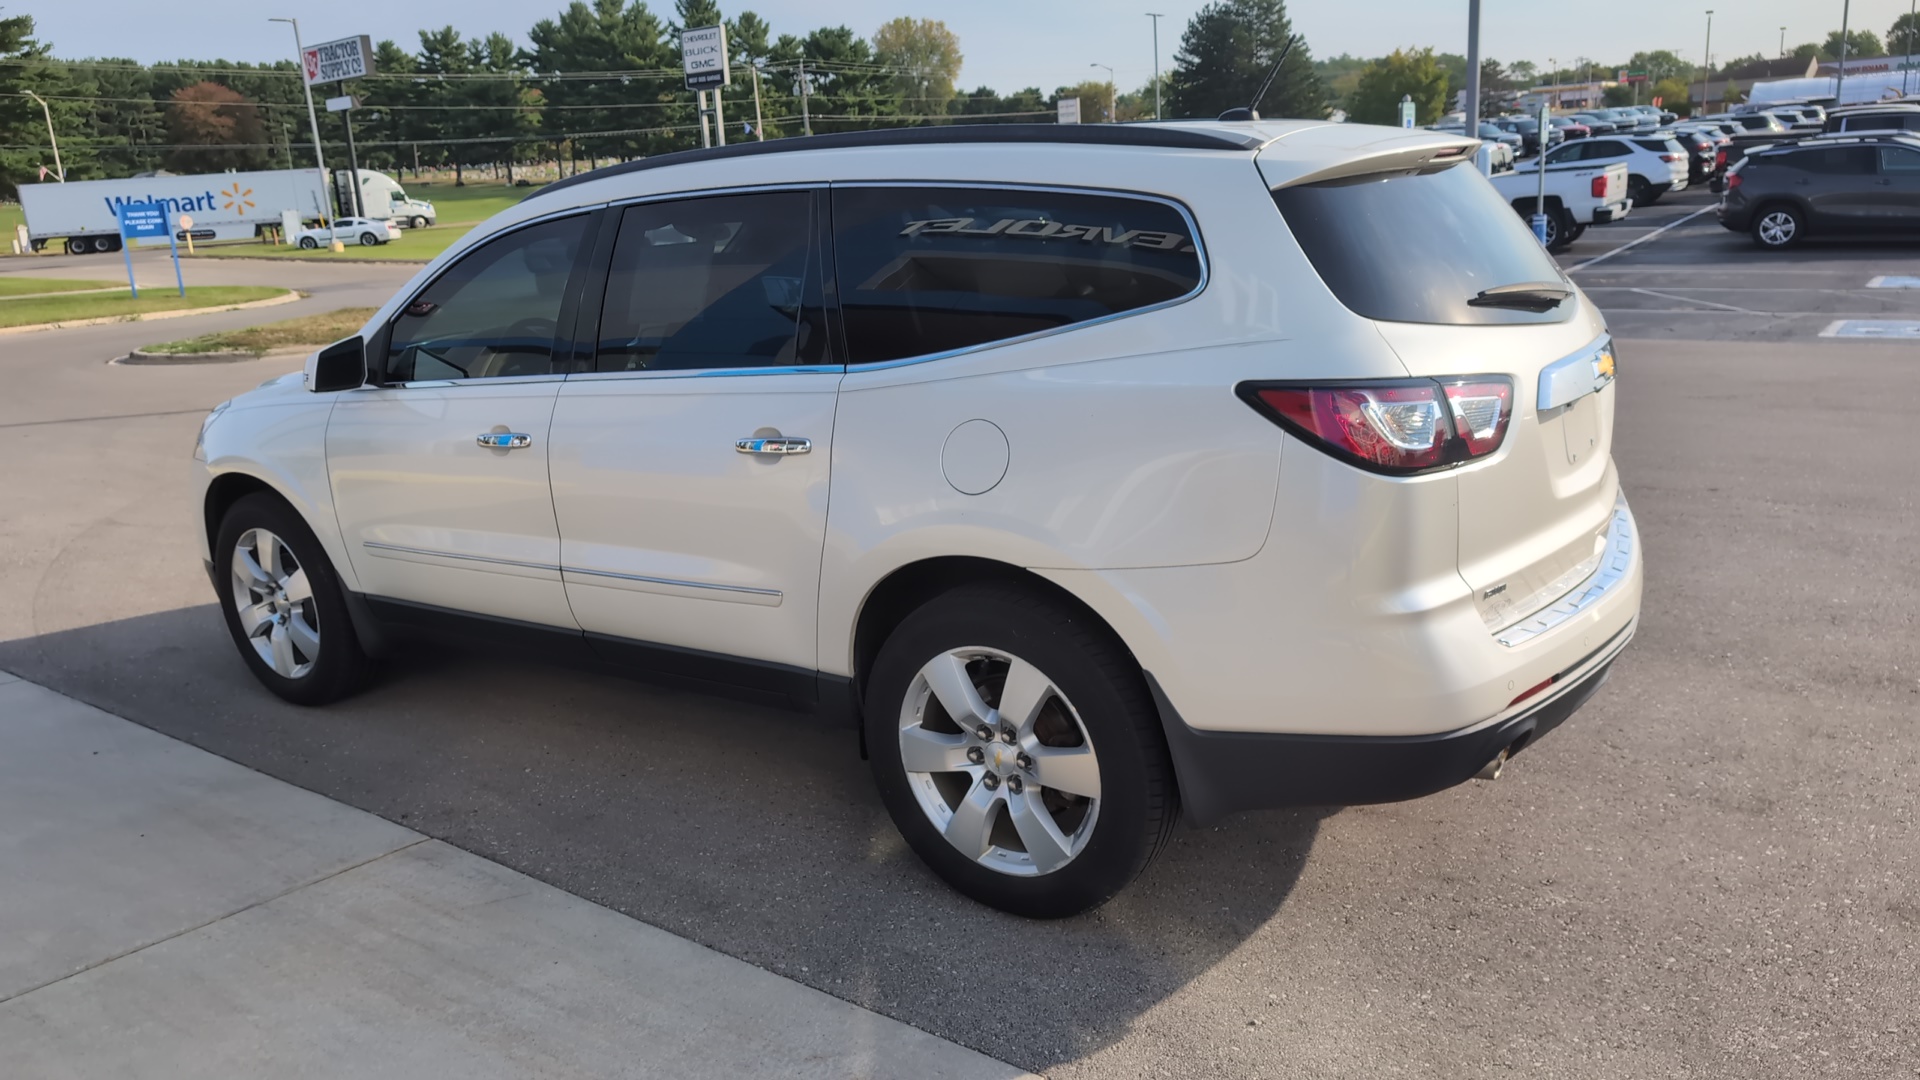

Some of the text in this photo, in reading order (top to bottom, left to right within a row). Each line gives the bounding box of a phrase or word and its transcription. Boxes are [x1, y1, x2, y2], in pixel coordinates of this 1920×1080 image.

[684, 32, 717, 43] CHEVROLET
[318, 40, 359, 63] TRACTOR
[685, 46, 718, 56] BUICK
[321, 59, 351, 80] SUPPLY
[691, 59, 715, 69] GMC
